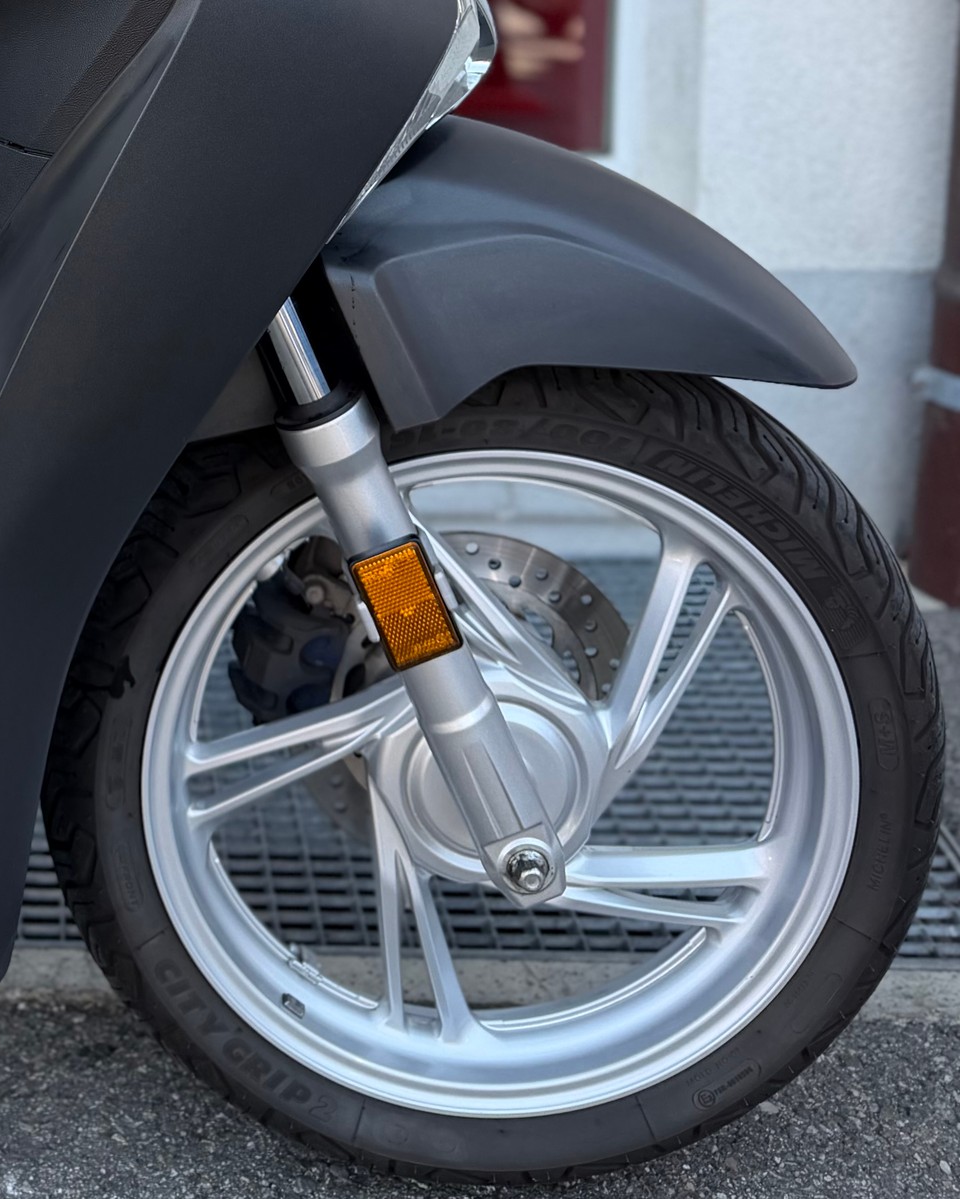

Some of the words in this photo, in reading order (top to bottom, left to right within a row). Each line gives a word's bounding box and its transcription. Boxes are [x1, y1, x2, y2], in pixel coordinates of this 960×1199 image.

[658, 451, 826, 583] MICHELIN
[876, 711, 896, 755] M+S
[154, 958, 230, 1039] CITY
[220, 1035, 313, 1106] GRIP
